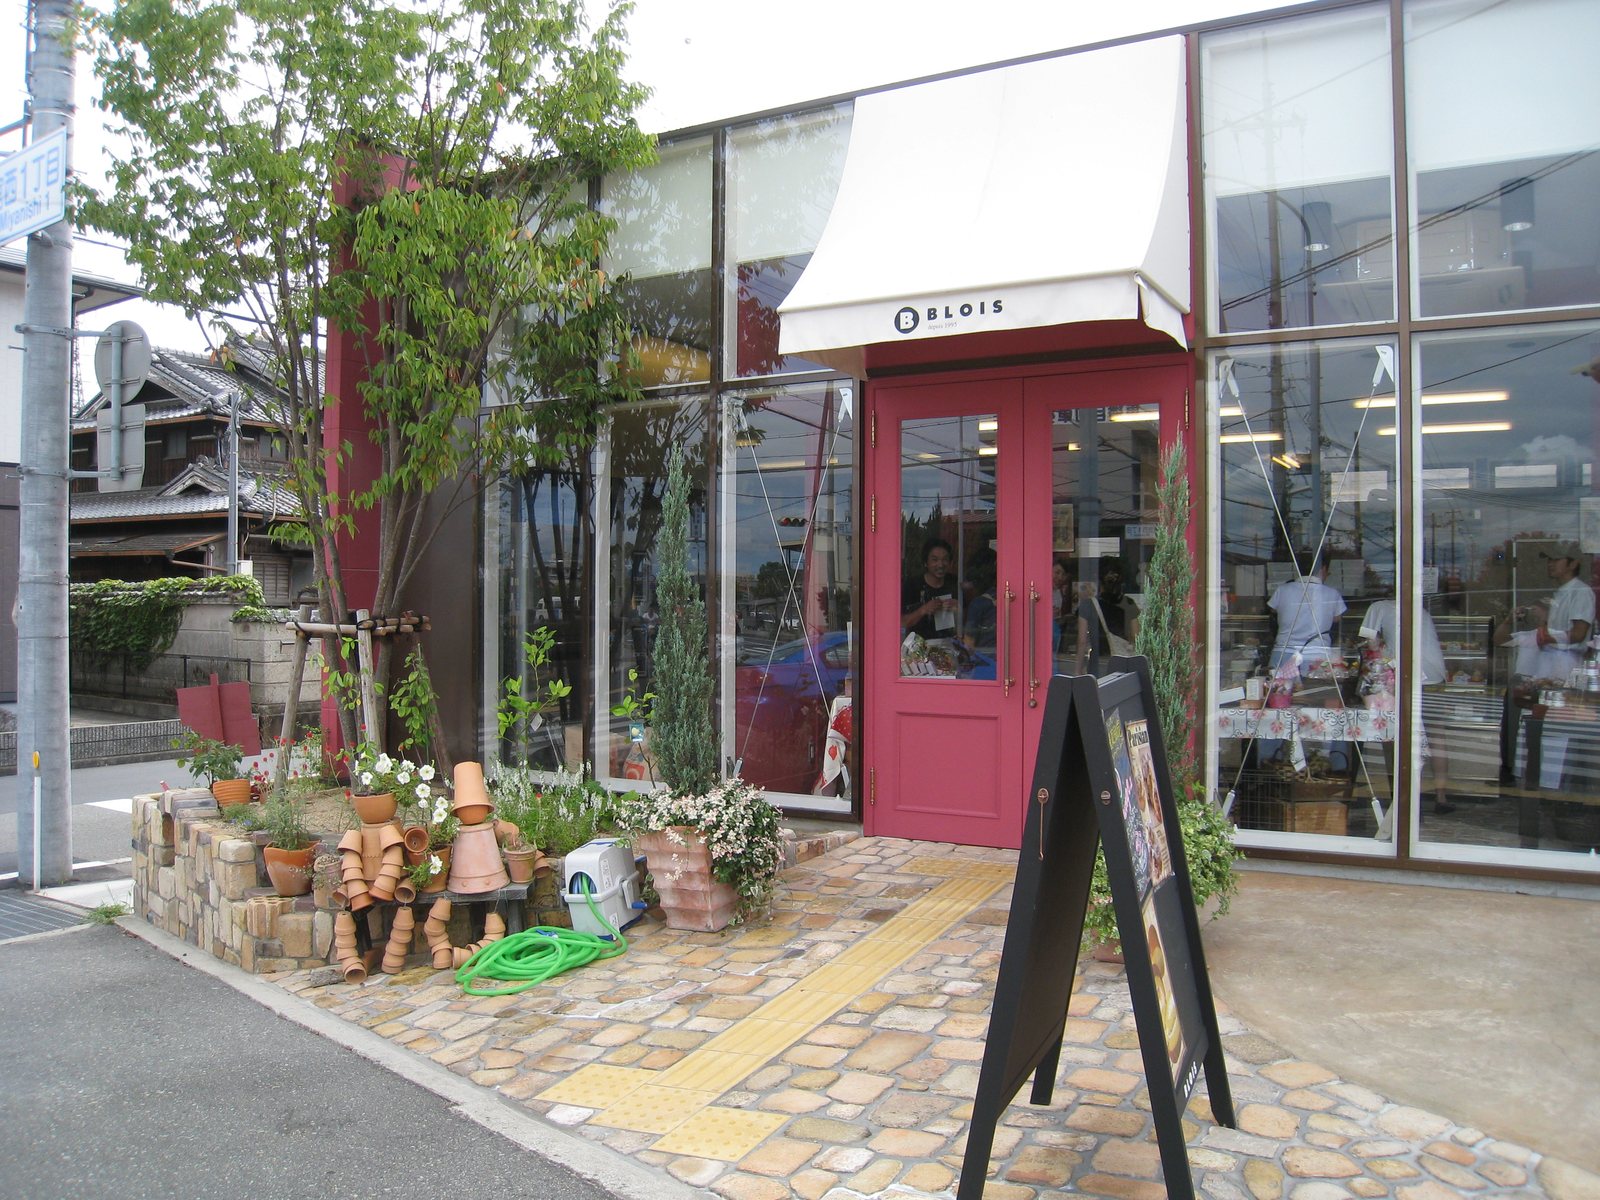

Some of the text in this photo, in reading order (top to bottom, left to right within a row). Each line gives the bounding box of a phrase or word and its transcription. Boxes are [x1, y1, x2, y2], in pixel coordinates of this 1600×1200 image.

[0, 146, 59, 209] 西1丁目
[927, 299, 1003, 320] BLOIS
